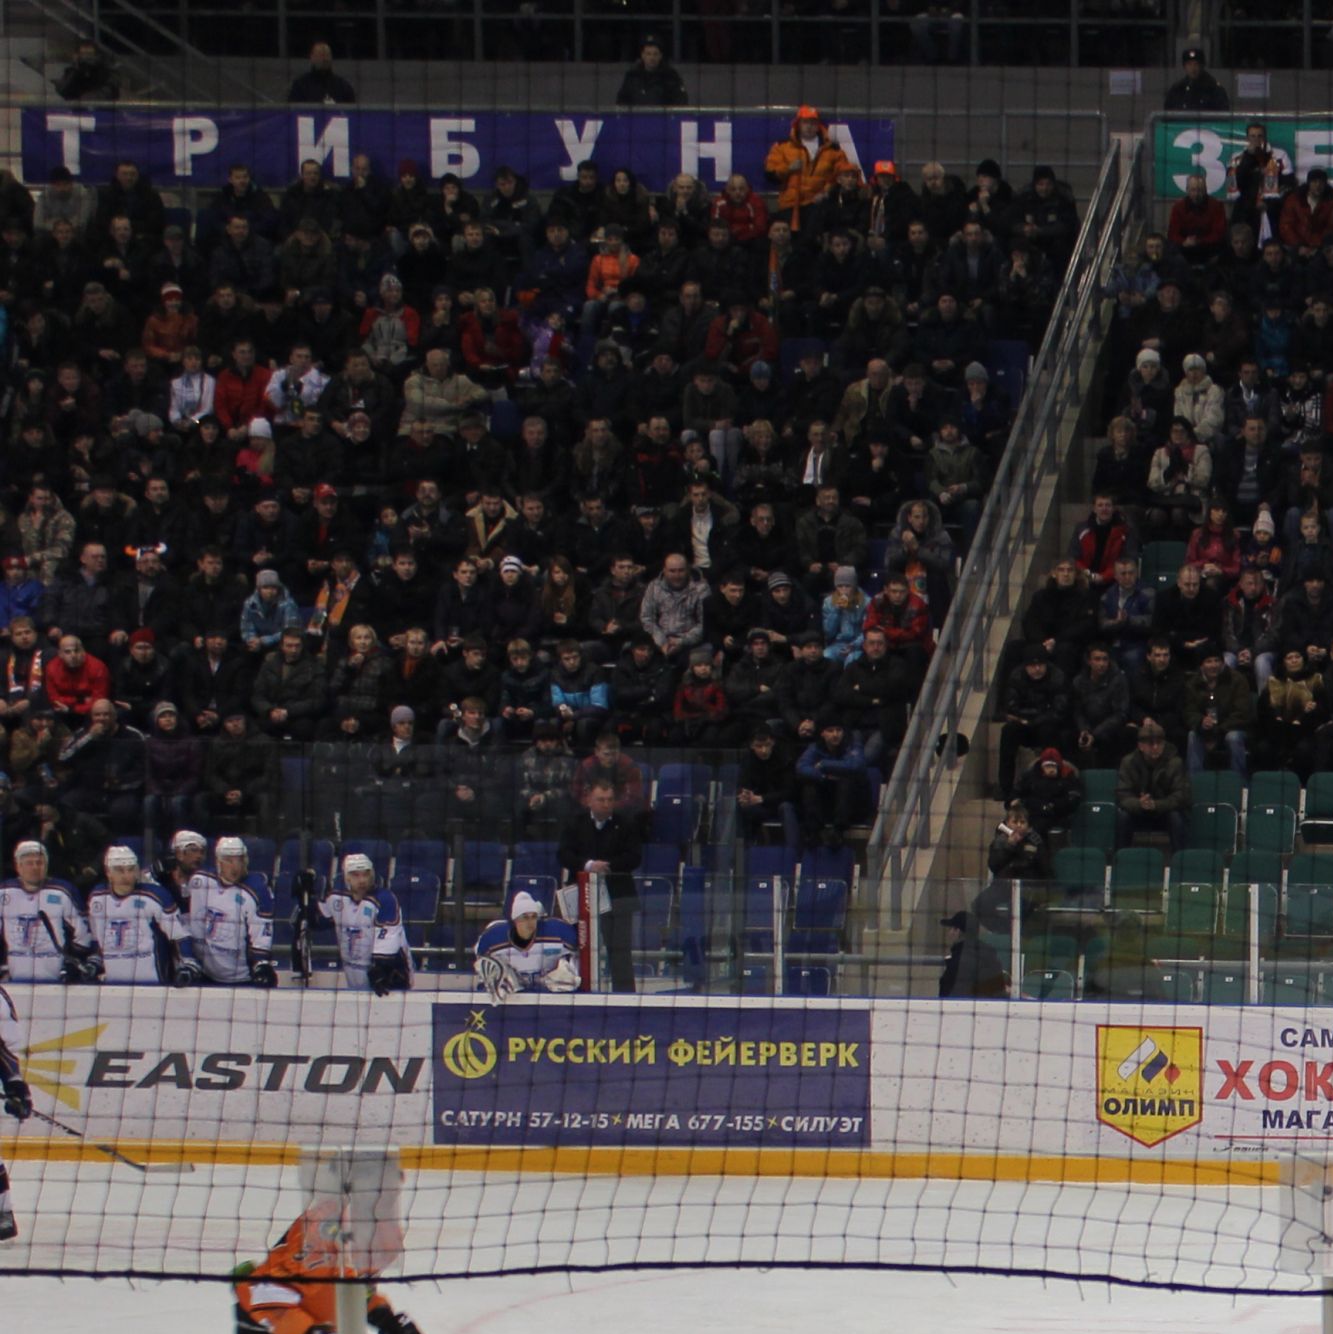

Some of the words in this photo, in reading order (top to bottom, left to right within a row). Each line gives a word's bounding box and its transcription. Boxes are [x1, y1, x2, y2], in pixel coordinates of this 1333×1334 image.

[508, 1034, 656, 1065] РУССКИЙ
[668, 1036, 860, 1068] ФЕЙЕРВЕРК
[86, 1051, 425, 1094] EASTON
[1103, 1097, 1195, 1117] ОЛИМП
[441, 1110, 522, 1128] САТУРН
[529, 1112, 609, 1130] 57-12-15
[626, 1113, 680, 1130] МЕГА
[688, 1114, 764, 1131] 677-155
[781, 1115, 863, 1133] СИЛУЭТ
